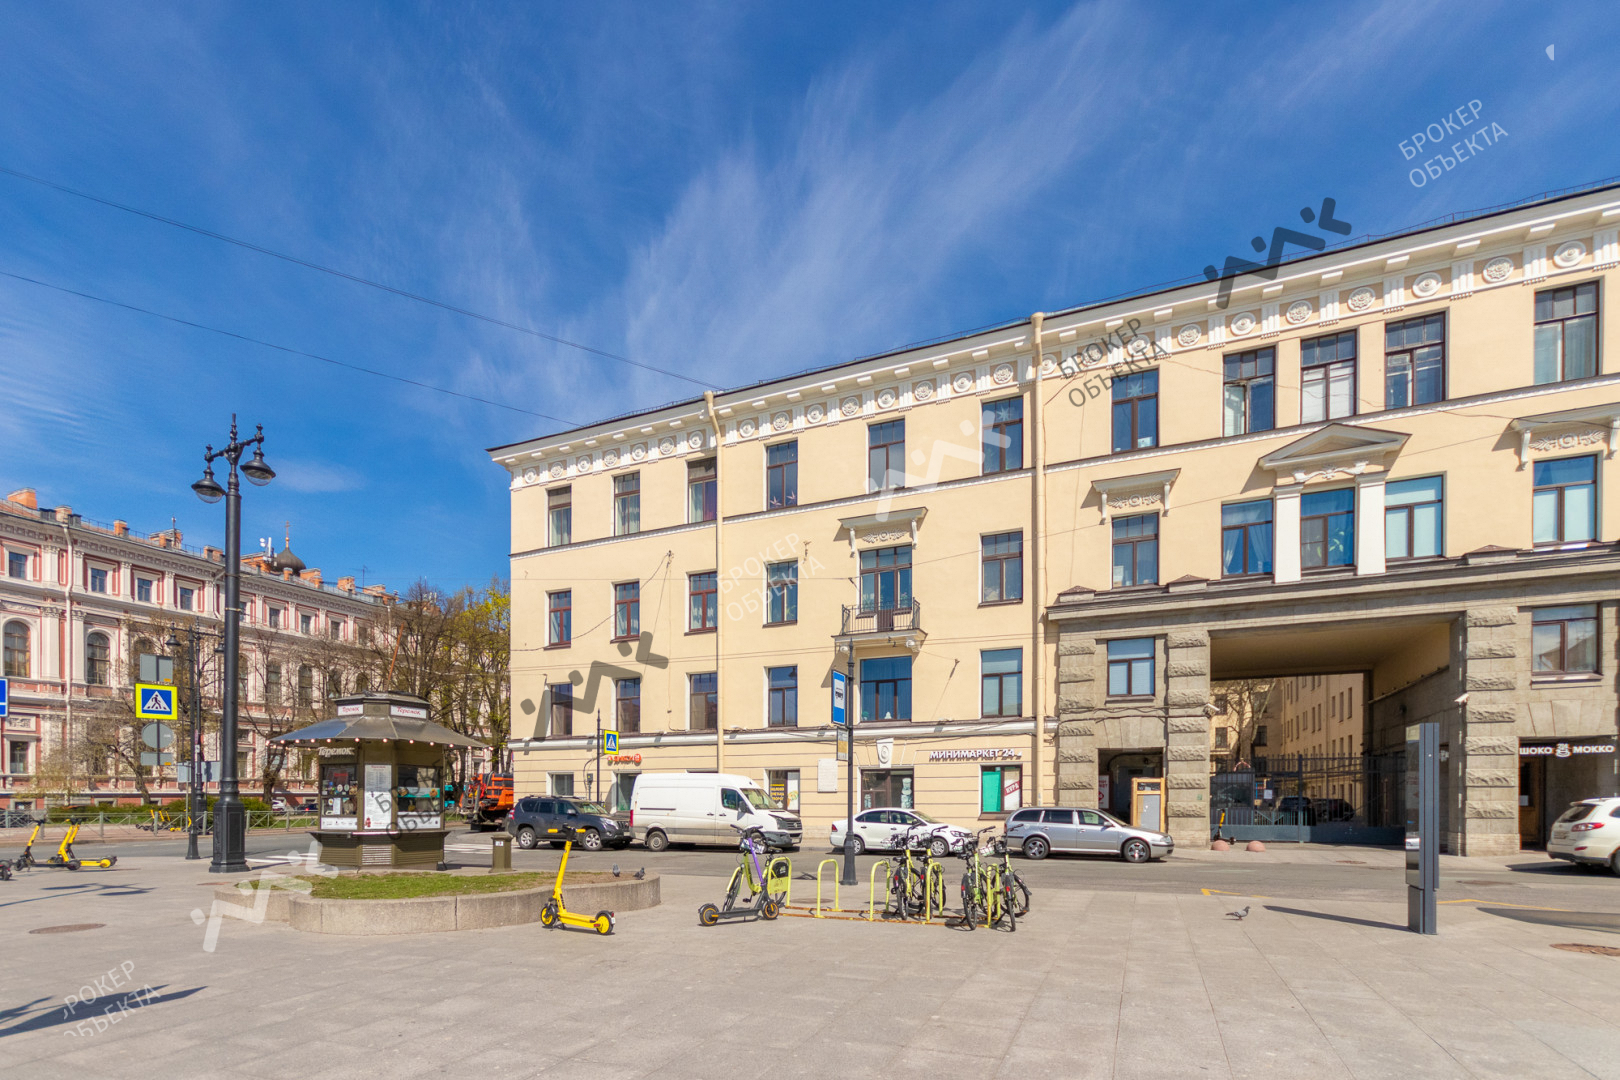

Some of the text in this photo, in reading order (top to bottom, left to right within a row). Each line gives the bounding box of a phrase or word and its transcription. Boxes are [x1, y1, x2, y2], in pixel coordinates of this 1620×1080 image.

[396, 706, 421, 715] Теремок
[318, 746, 355, 757] Теремок
[929, 748, 1015, 759] МИНИМАРКЕТ 24
[1519, 744, 1616, 755] ШОКО МОККО
